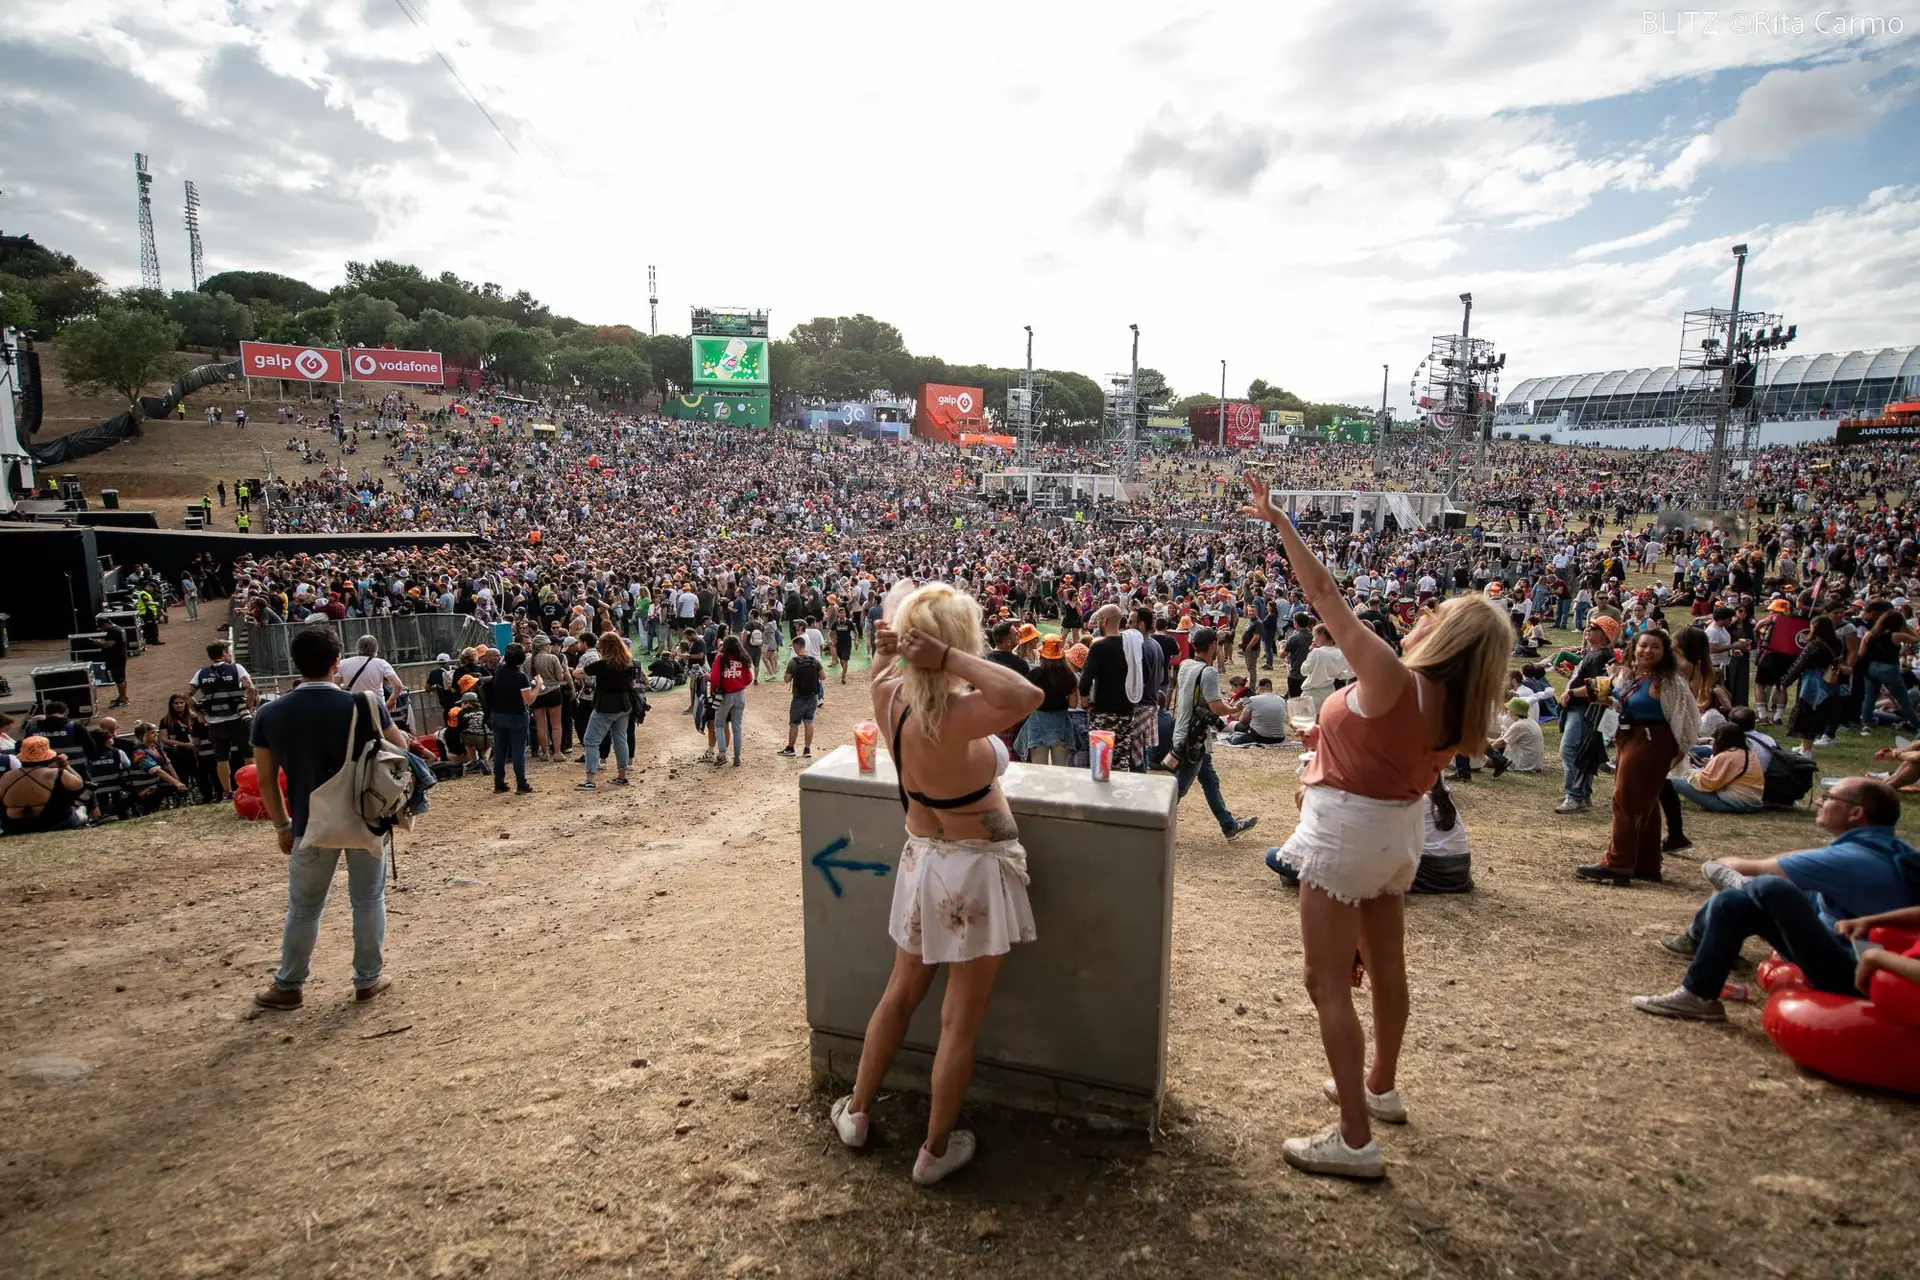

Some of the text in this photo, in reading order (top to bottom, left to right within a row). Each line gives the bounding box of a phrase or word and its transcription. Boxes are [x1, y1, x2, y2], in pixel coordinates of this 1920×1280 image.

[254, 353, 292, 370] galp
[379, 360, 438, 373] vodafone
[938, 394, 957, 406] galp
[1858, 426, 1899, 436] JUNTOS
[201, 675, 234, 683] PRS
